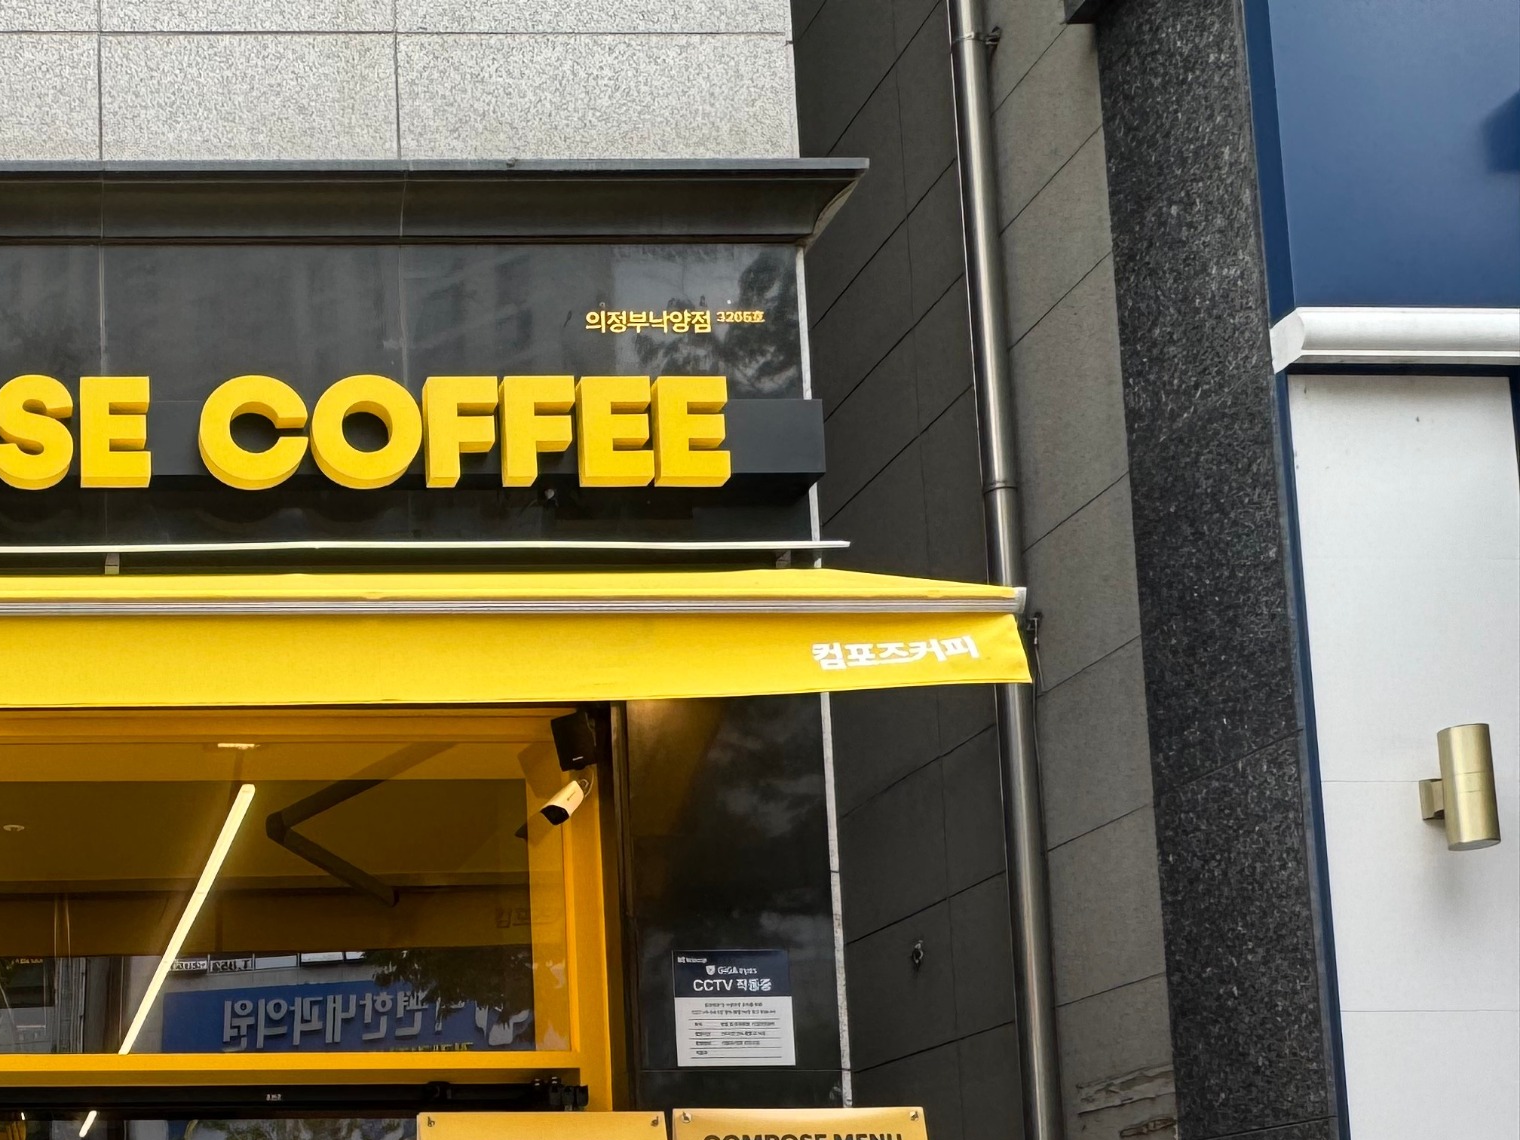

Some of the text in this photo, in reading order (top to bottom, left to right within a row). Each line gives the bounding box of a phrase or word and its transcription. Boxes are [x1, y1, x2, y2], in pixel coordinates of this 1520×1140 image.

[585, 309, 712, 334] 의정부낙양점
[199, 374, 732, 490] COFFEE
[811, 634, 981, 672] 컴포즈커피
[692, 979, 733, 992] CCTV
